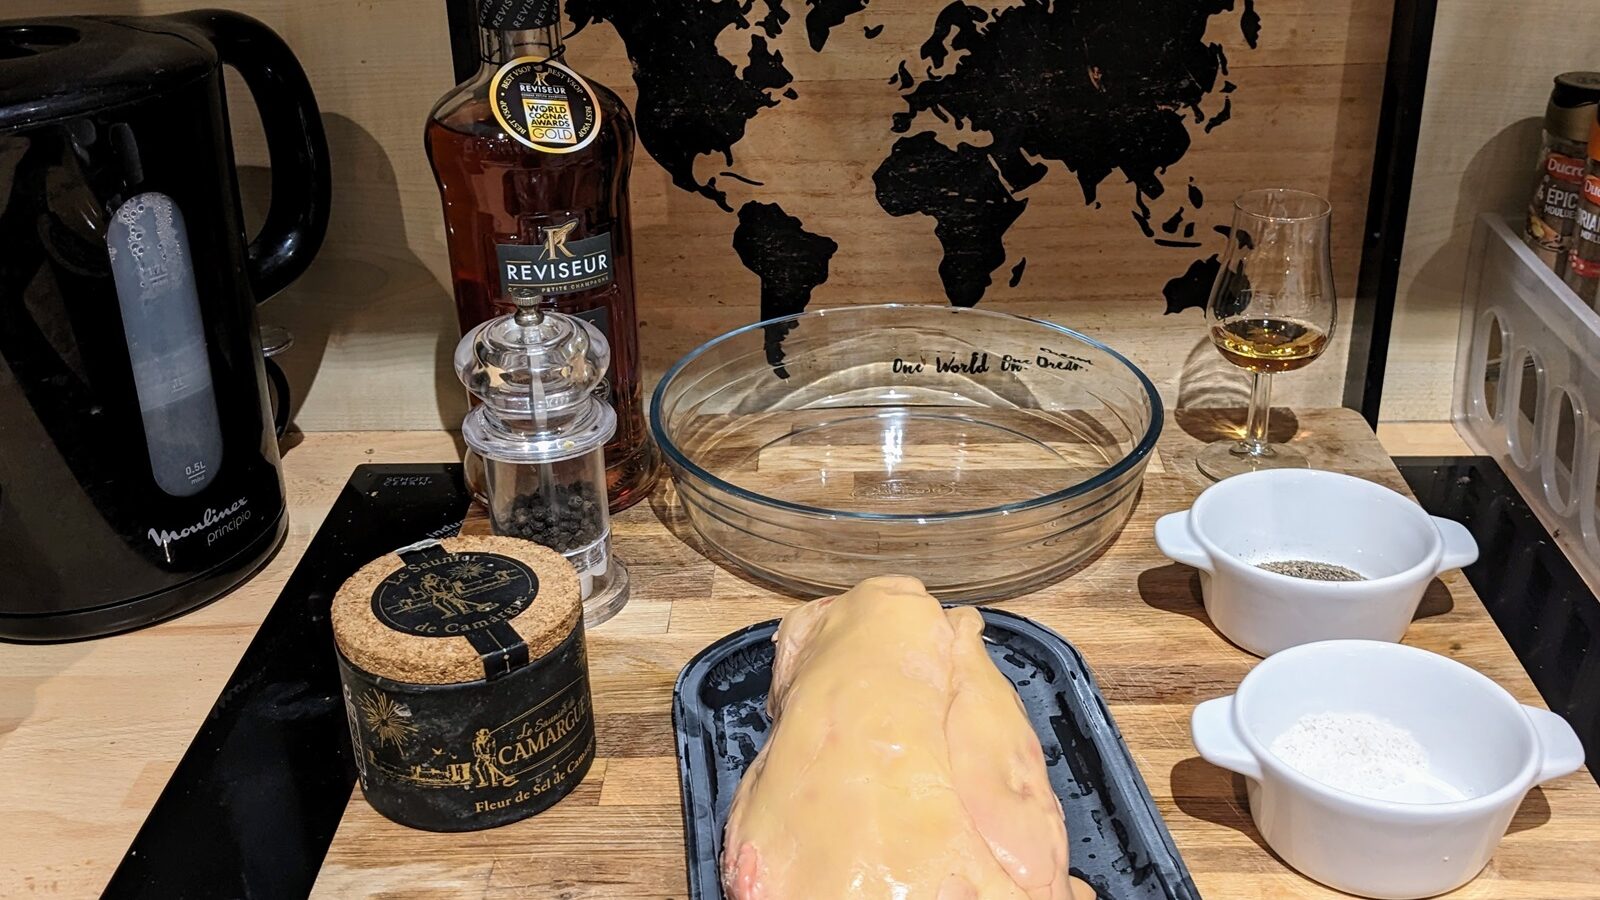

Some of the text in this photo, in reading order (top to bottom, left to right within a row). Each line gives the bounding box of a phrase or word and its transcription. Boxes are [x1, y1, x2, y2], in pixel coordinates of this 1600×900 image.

[501, 65, 532, 89] BEST VSOP
[547, 67, 584, 94] BEST VSOP
[520, 84, 566, 95] REVISEUR
[527, 104, 567, 114] WORLD
[528, 112, 569, 121] COGNAC
[531, 119, 570, 128] AWARDS
[532, 128, 573, 140] GOLD
[506, 254, 608, 281] REVISEUR
[541, 276, 609, 293] PETITE CHAMPAGNE
[935, 351, 989, 374] World
[185, 461, 206, 476] 0.5L
[147, 497, 248, 547] Moulinex
[207, 510, 251, 547] principio
[414, 622, 438, 633] de
[499, 694, 587, 766] CAMARGUE
[474, 799, 512, 814] Fleur
[514, 791, 531, 804] de
[533, 777, 551, 796] Sel
[553, 771, 567, 785] de
